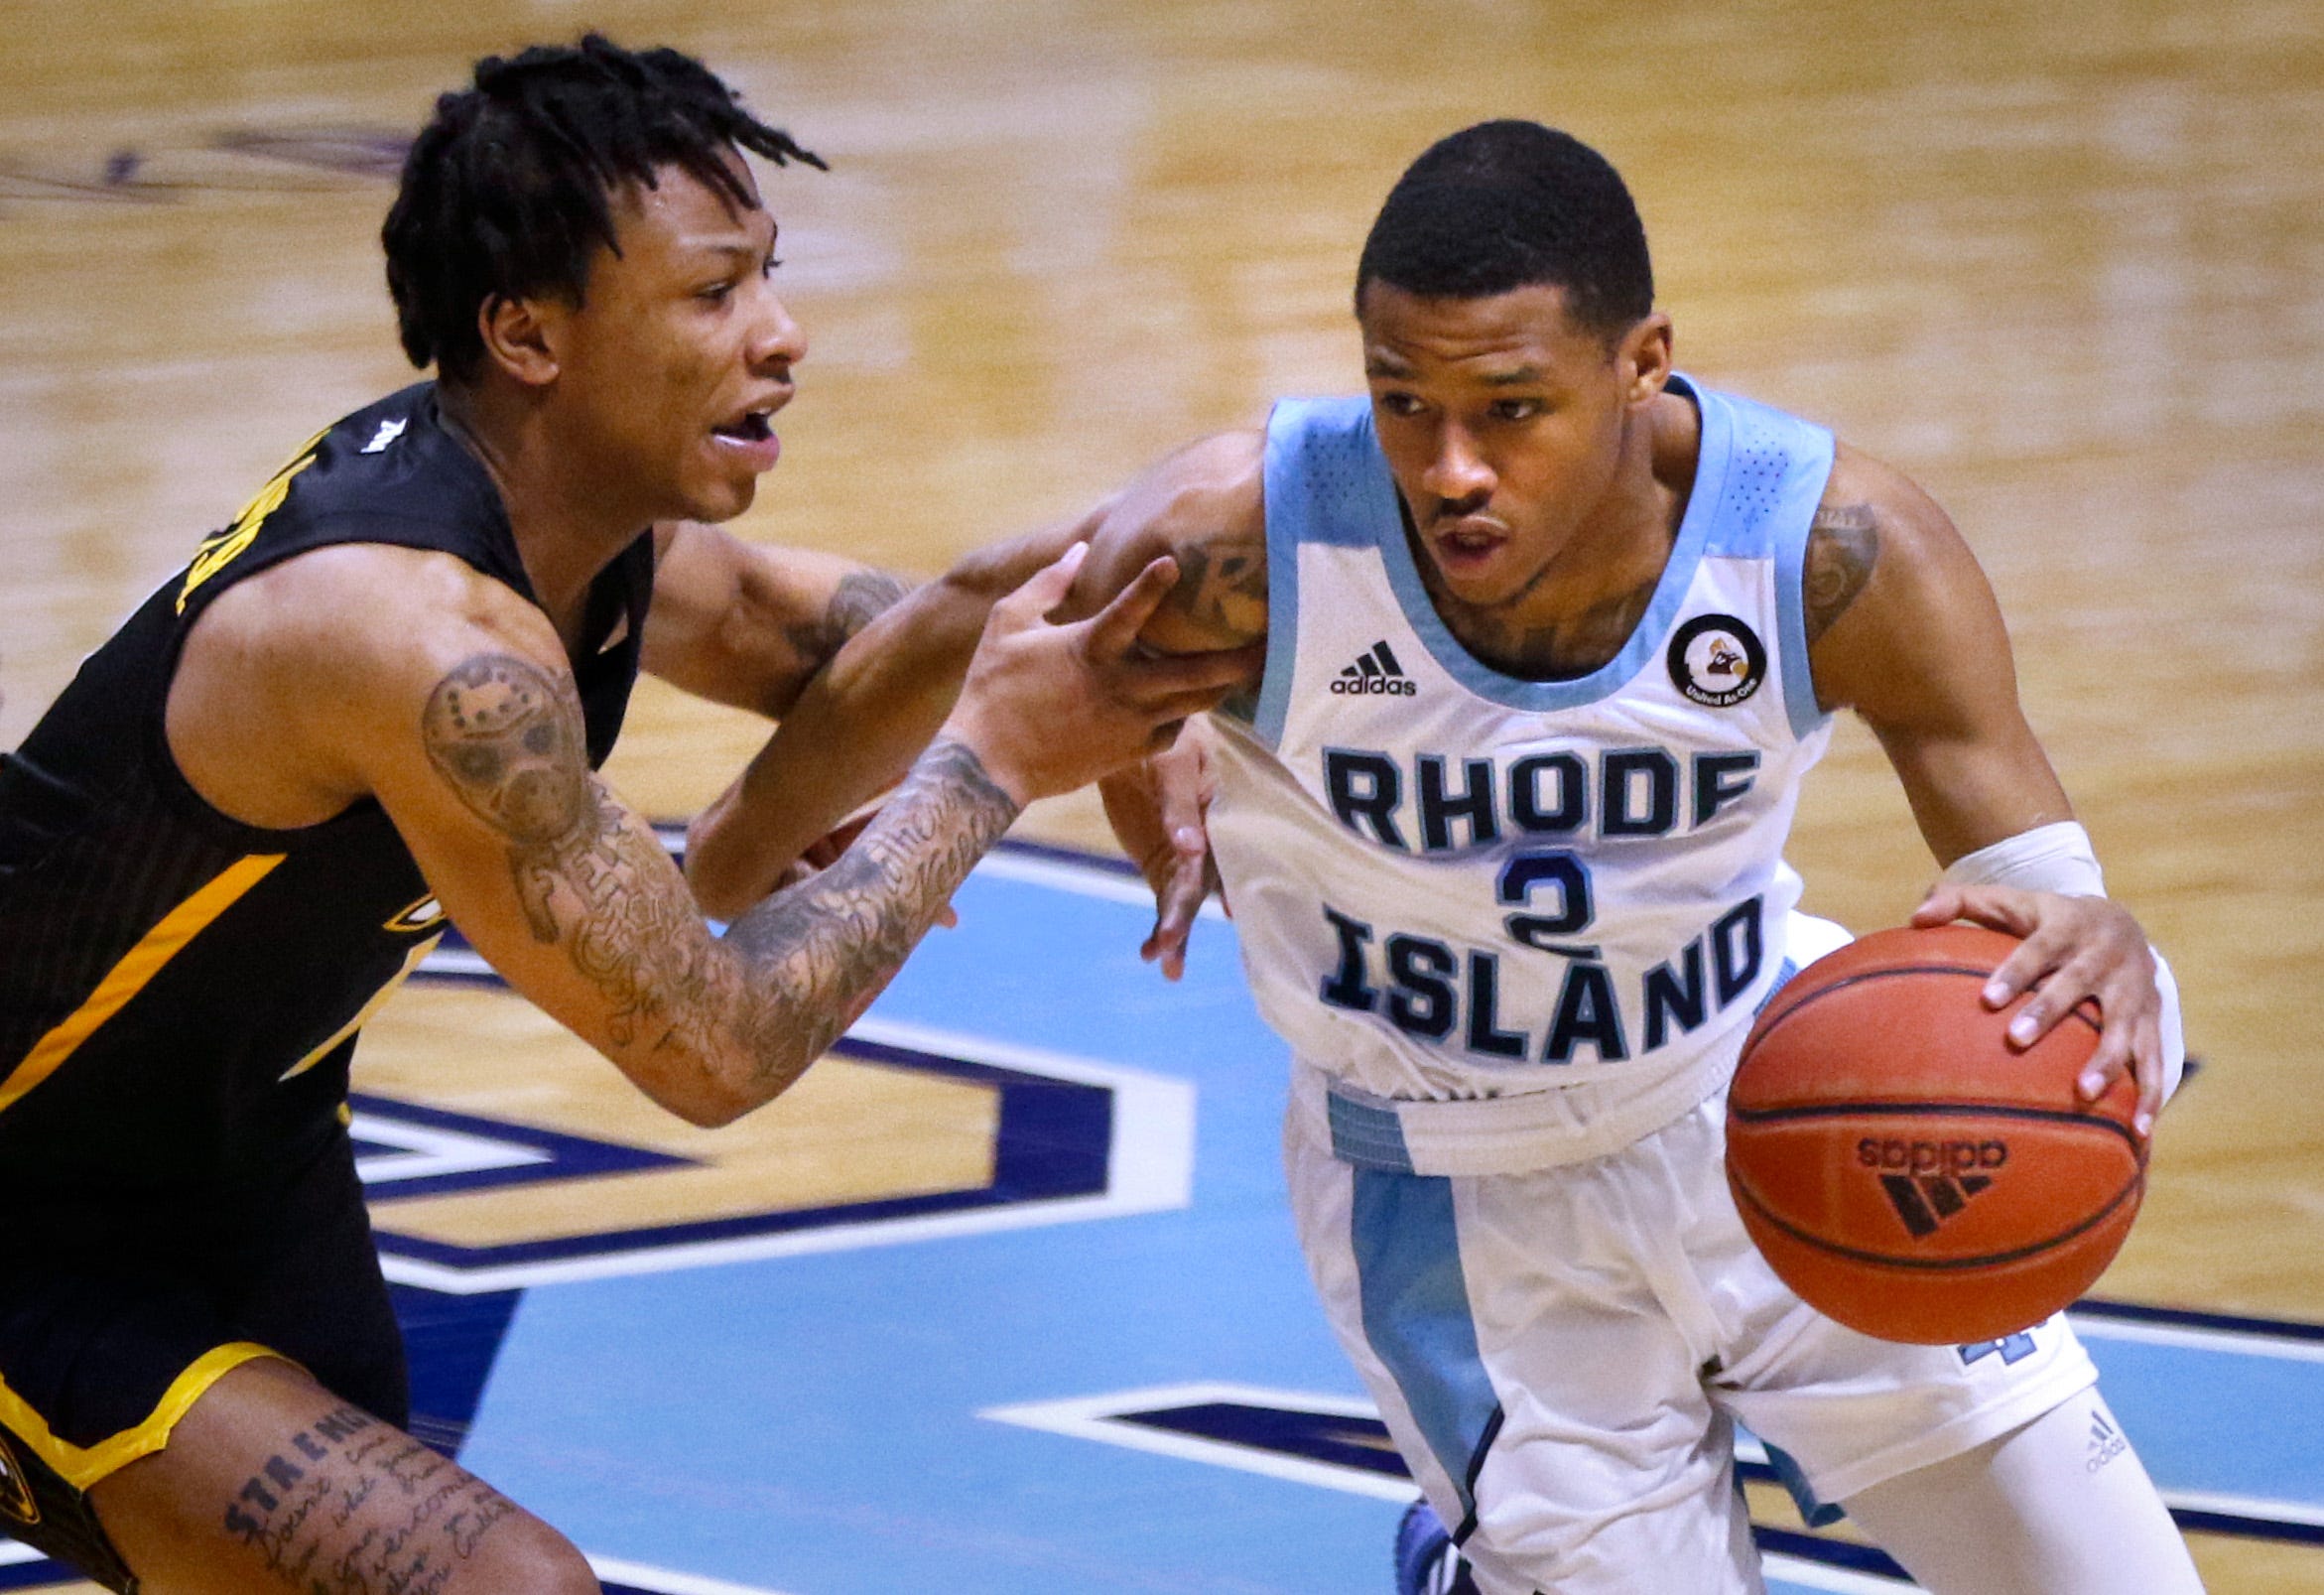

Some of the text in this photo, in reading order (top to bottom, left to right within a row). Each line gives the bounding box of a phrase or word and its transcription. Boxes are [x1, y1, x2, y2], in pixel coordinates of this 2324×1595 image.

[1330, 676, 1416, 696] adidas
[1686, 685, 1722, 705] United
[1495, 849, 1603, 961] 2
[1319, 893, 1764, 1065] ISLAND
[1858, 1137, 2008, 1178] adidas
